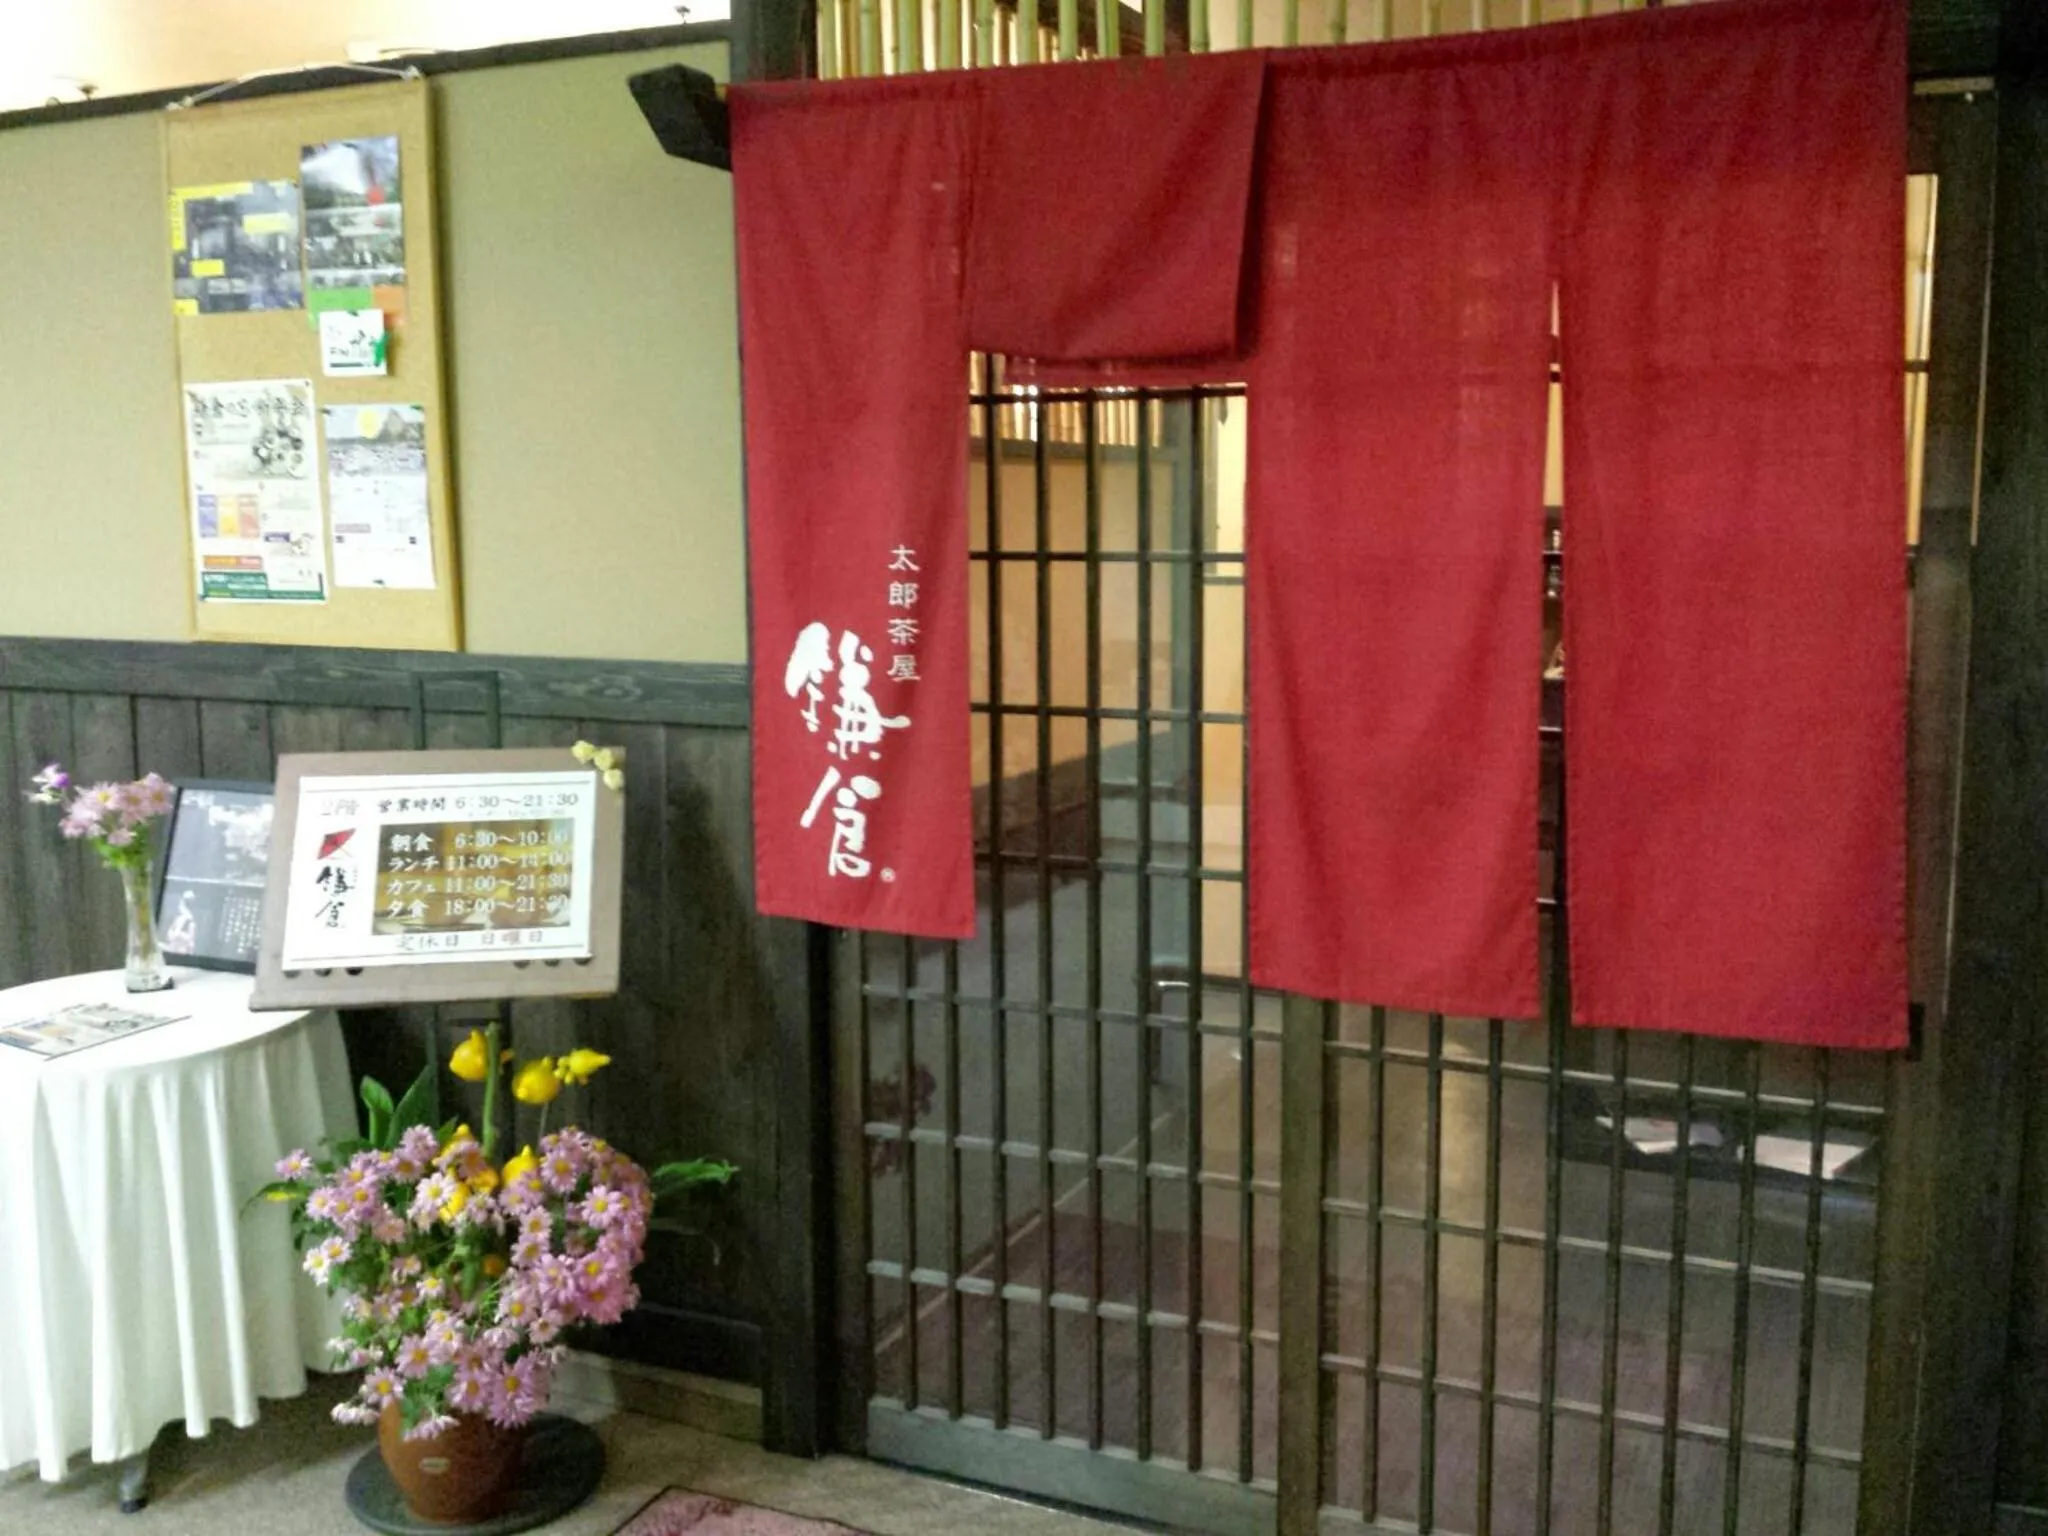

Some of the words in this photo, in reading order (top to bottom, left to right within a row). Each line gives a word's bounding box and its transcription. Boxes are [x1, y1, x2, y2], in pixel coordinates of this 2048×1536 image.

[887, 544, 921, 682] 太郎茶屋
[388, 855, 440, 873] ランチ
[386, 878, 437, 896] カフェ
[386, 898, 430, 919] 夕食
